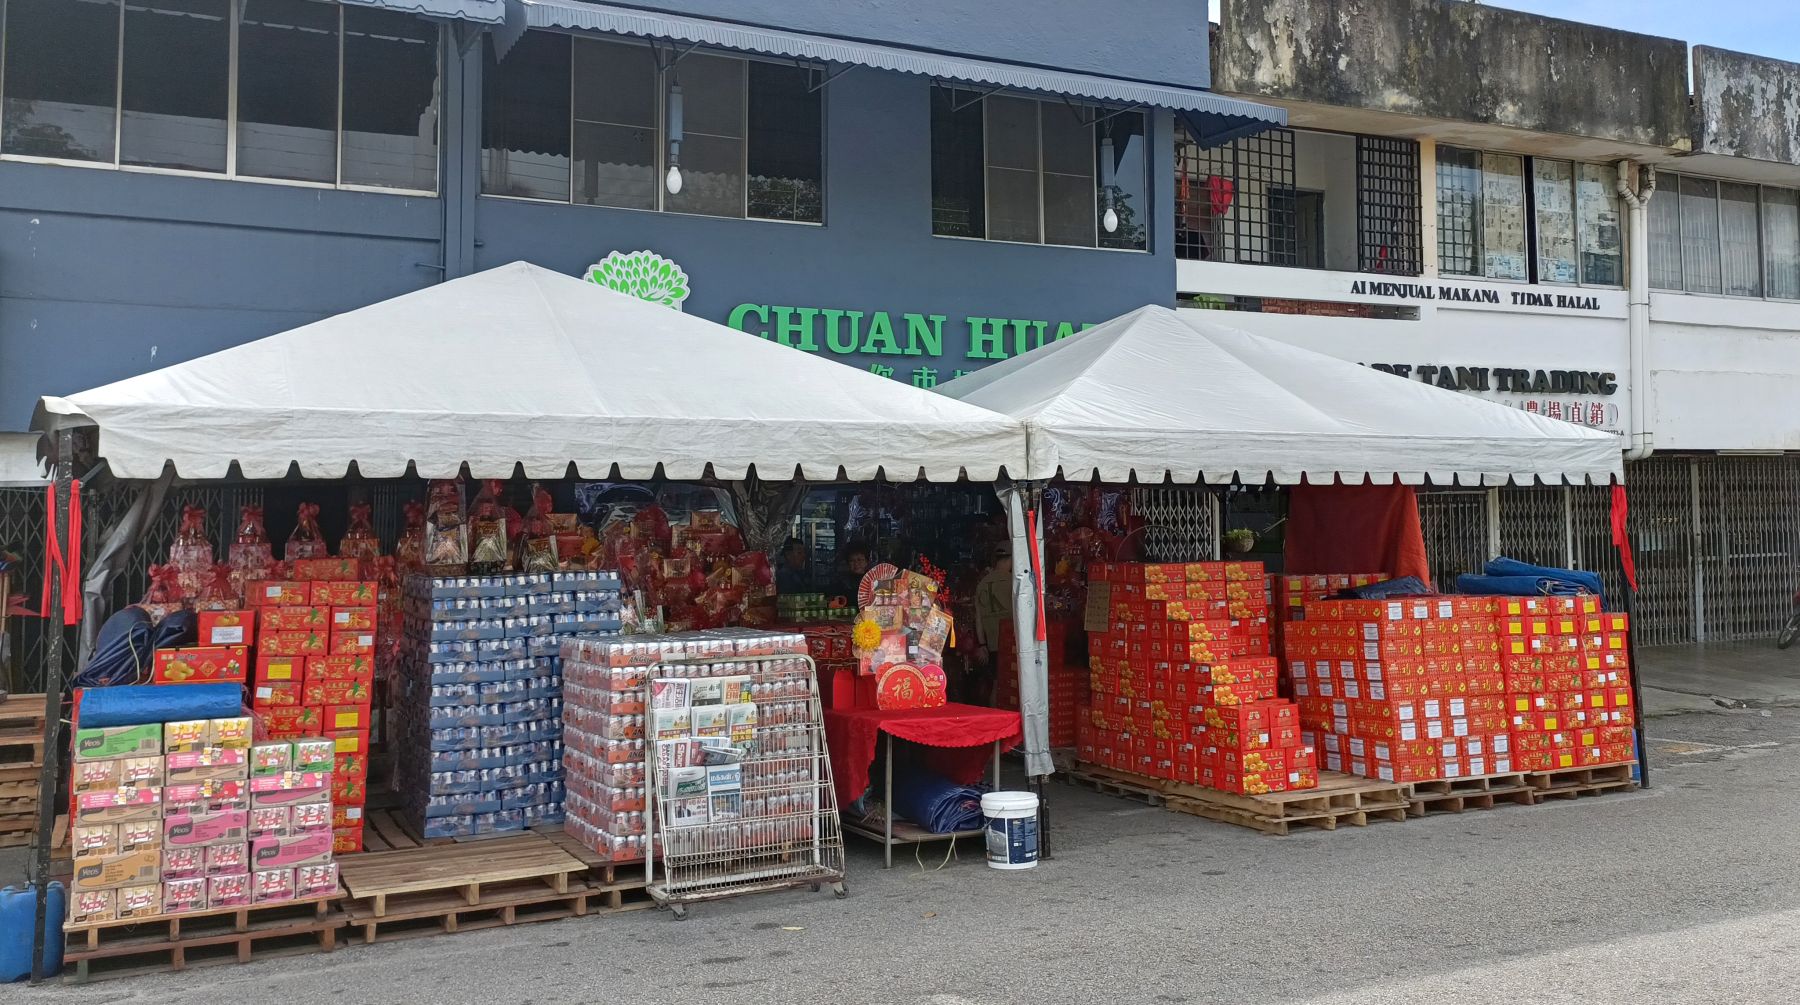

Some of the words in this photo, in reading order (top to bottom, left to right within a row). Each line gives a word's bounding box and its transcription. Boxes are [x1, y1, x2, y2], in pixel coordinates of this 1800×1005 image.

[1369, 281, 1436, 300] MENJUAL
[1438, 286, 1500, 304] MAKANA
[1511, 291, 1554, 307] TIDAK
[1556, 294, 1600, 310] HALAL
[728, 303, 947, 356] CHUAN
[1416, 365, 1491, 392] TANI
[1492, 368, 1618, 396] TRADING
[892, 677, 914, 700] 福
